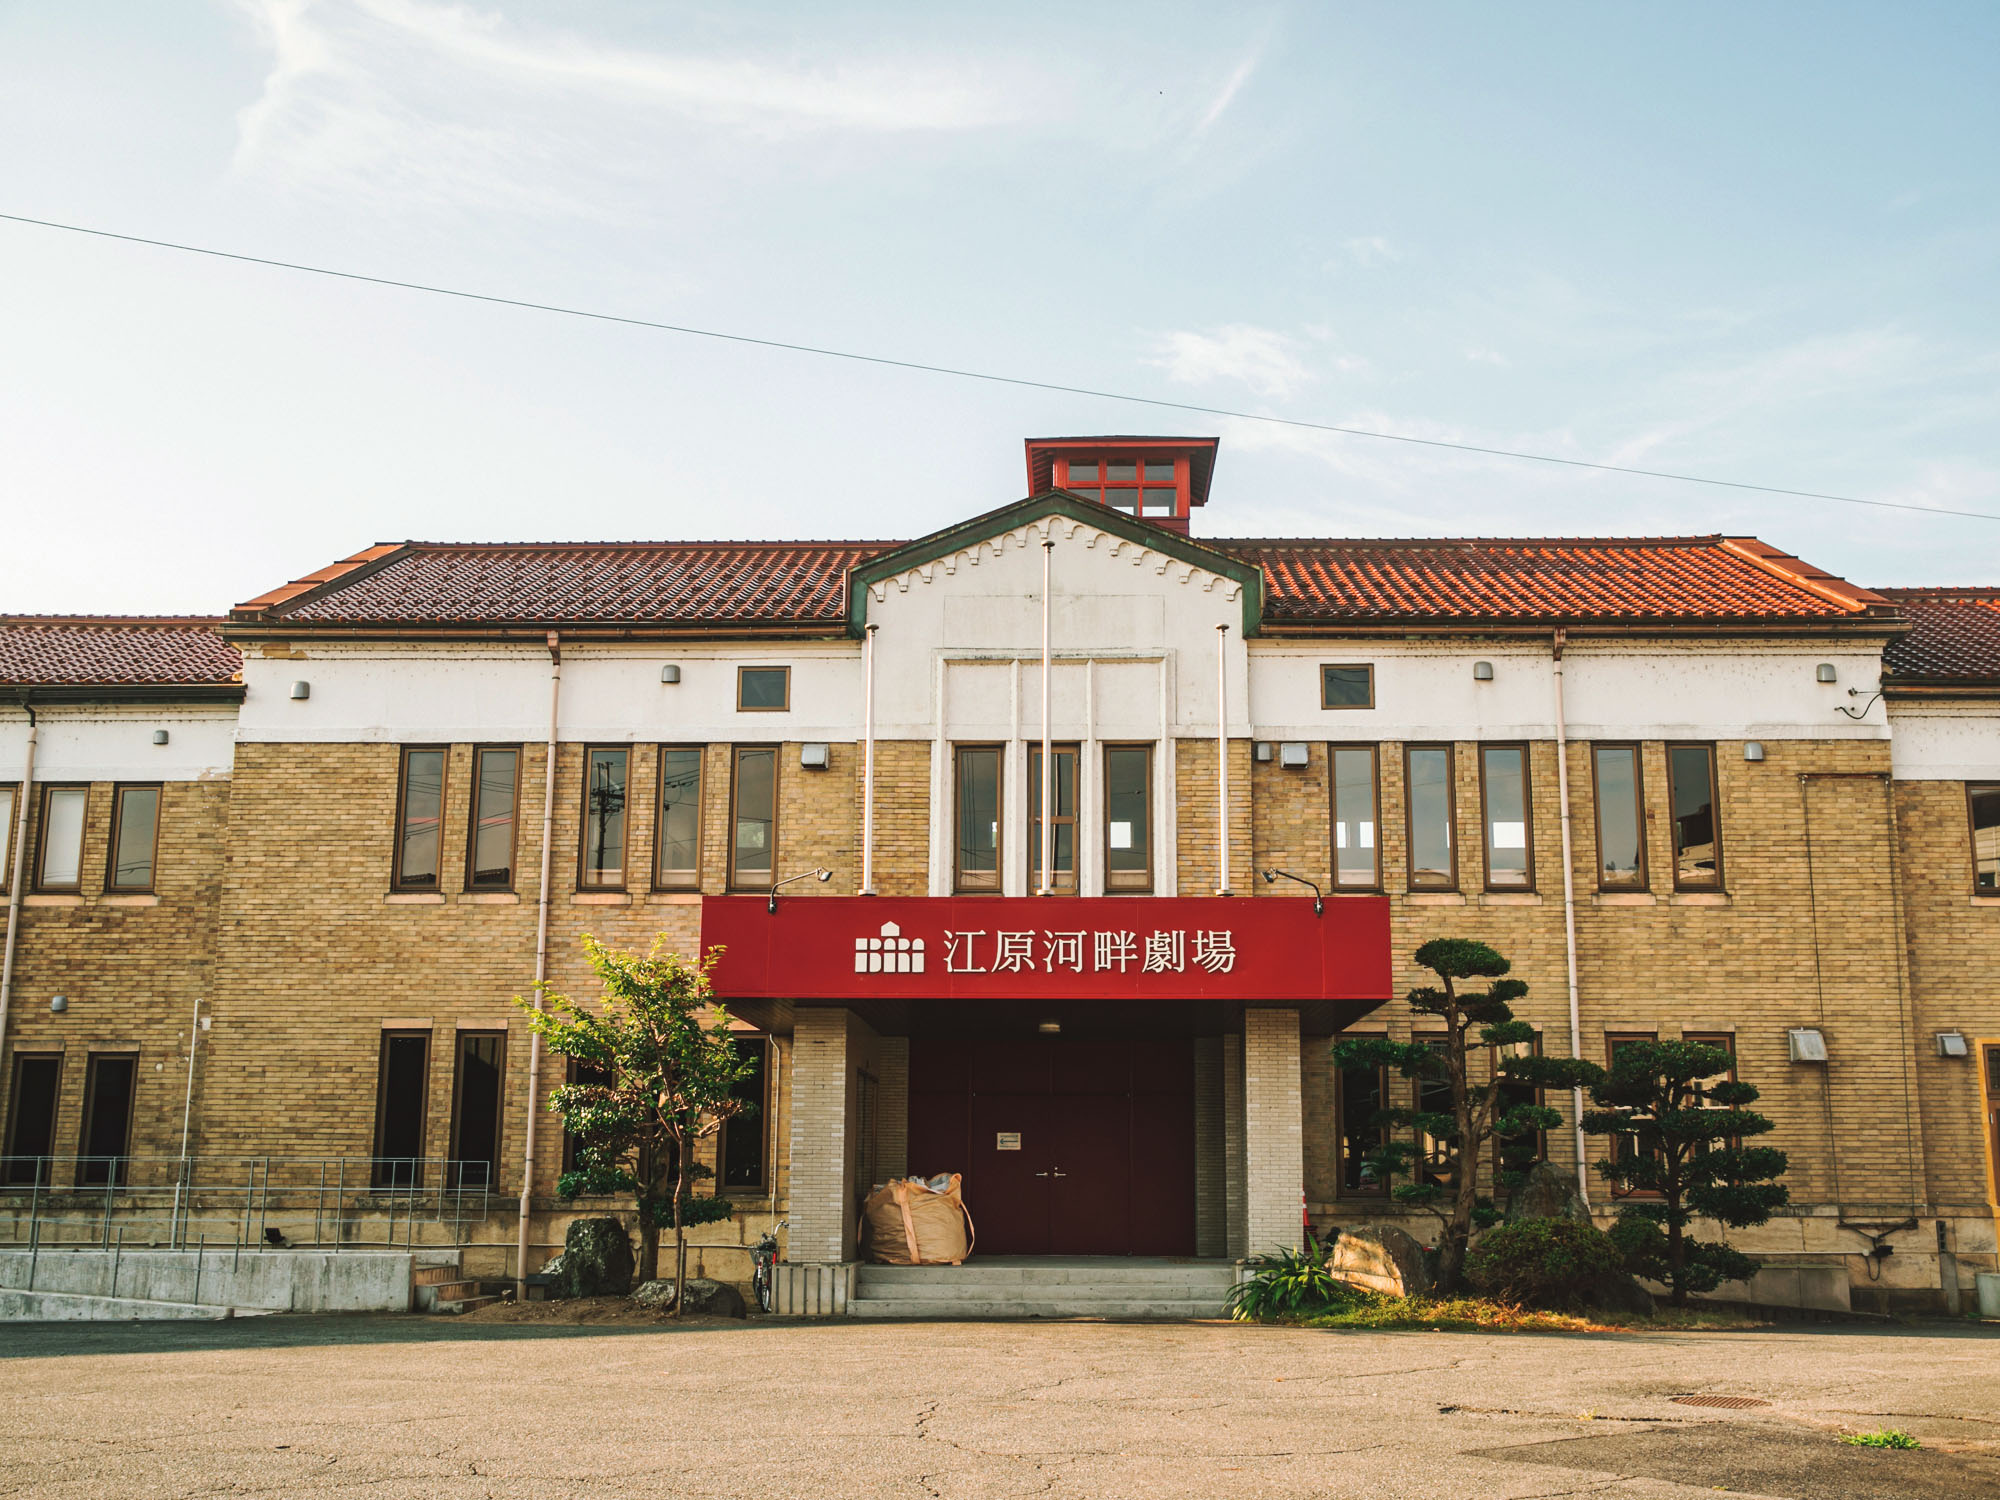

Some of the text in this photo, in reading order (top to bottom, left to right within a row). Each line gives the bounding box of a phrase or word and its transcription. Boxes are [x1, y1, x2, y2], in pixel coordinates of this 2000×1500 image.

[943, 929, 1236, 974] 江原河畔劇場
